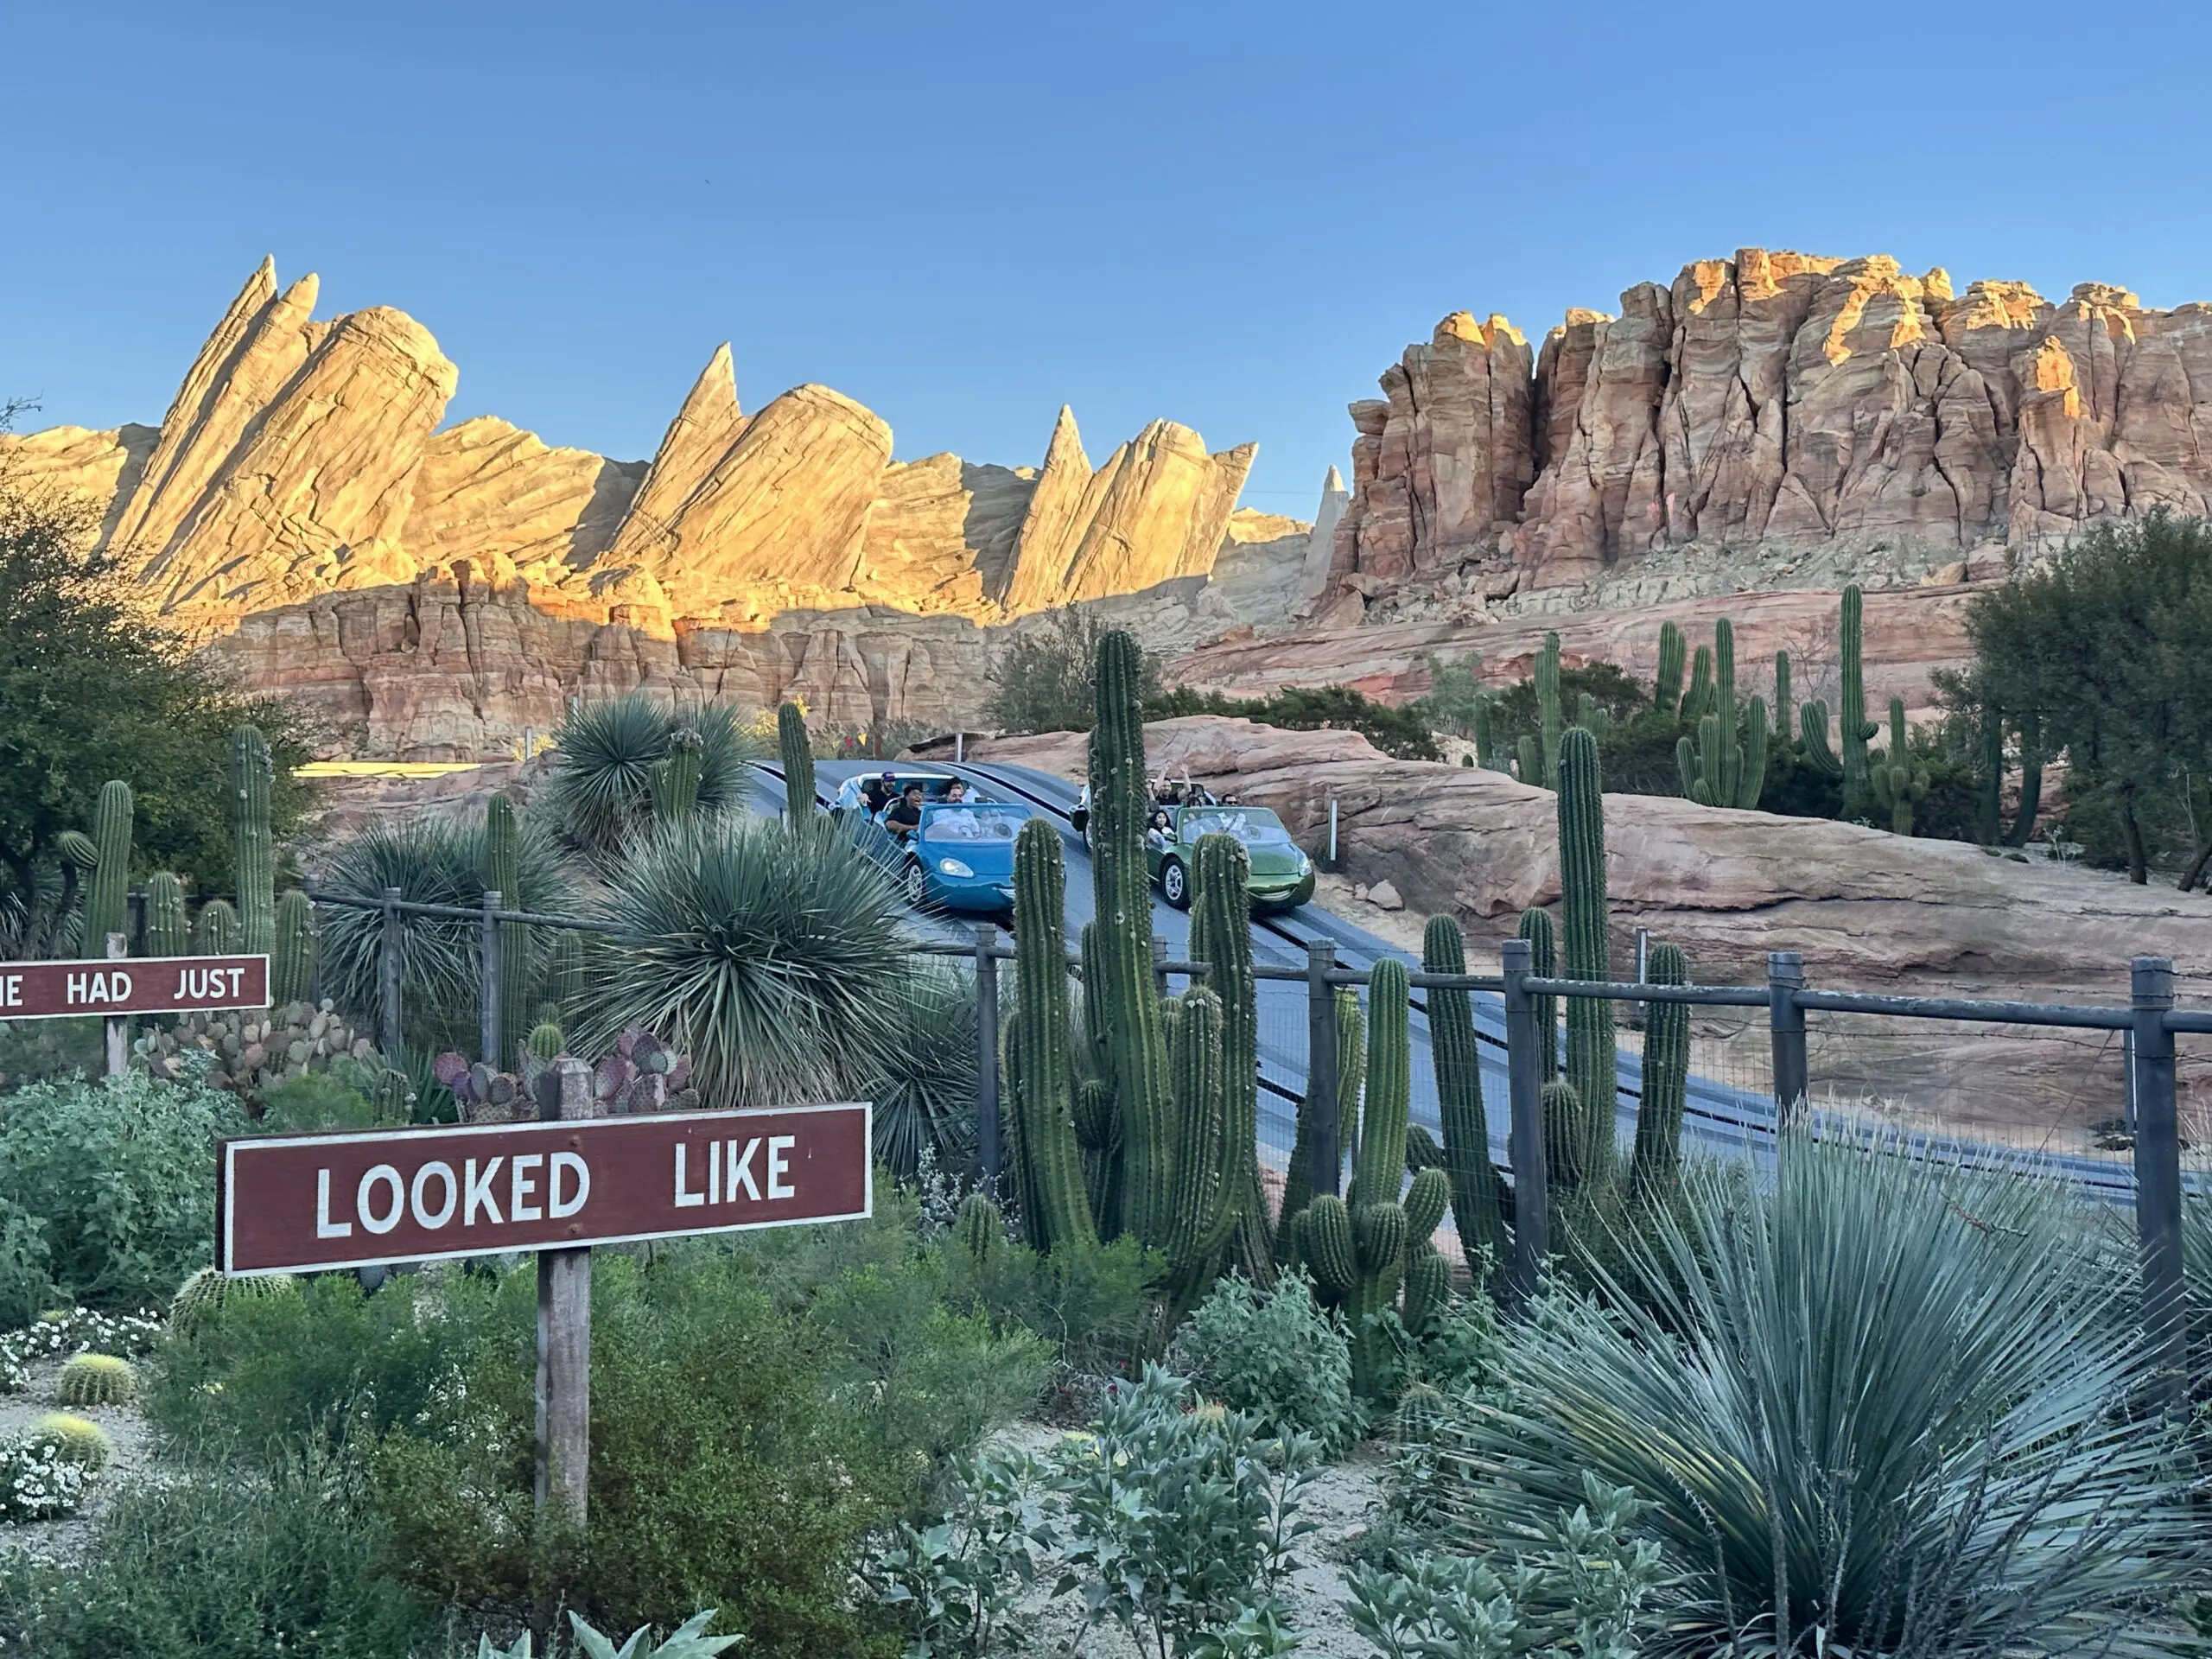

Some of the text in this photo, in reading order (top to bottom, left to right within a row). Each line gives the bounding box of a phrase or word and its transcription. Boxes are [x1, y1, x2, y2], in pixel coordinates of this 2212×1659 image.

[0, 967, 245, 1007] E HAD JUST
[316, 1135, 796, 1239] LOOKED LIKE
